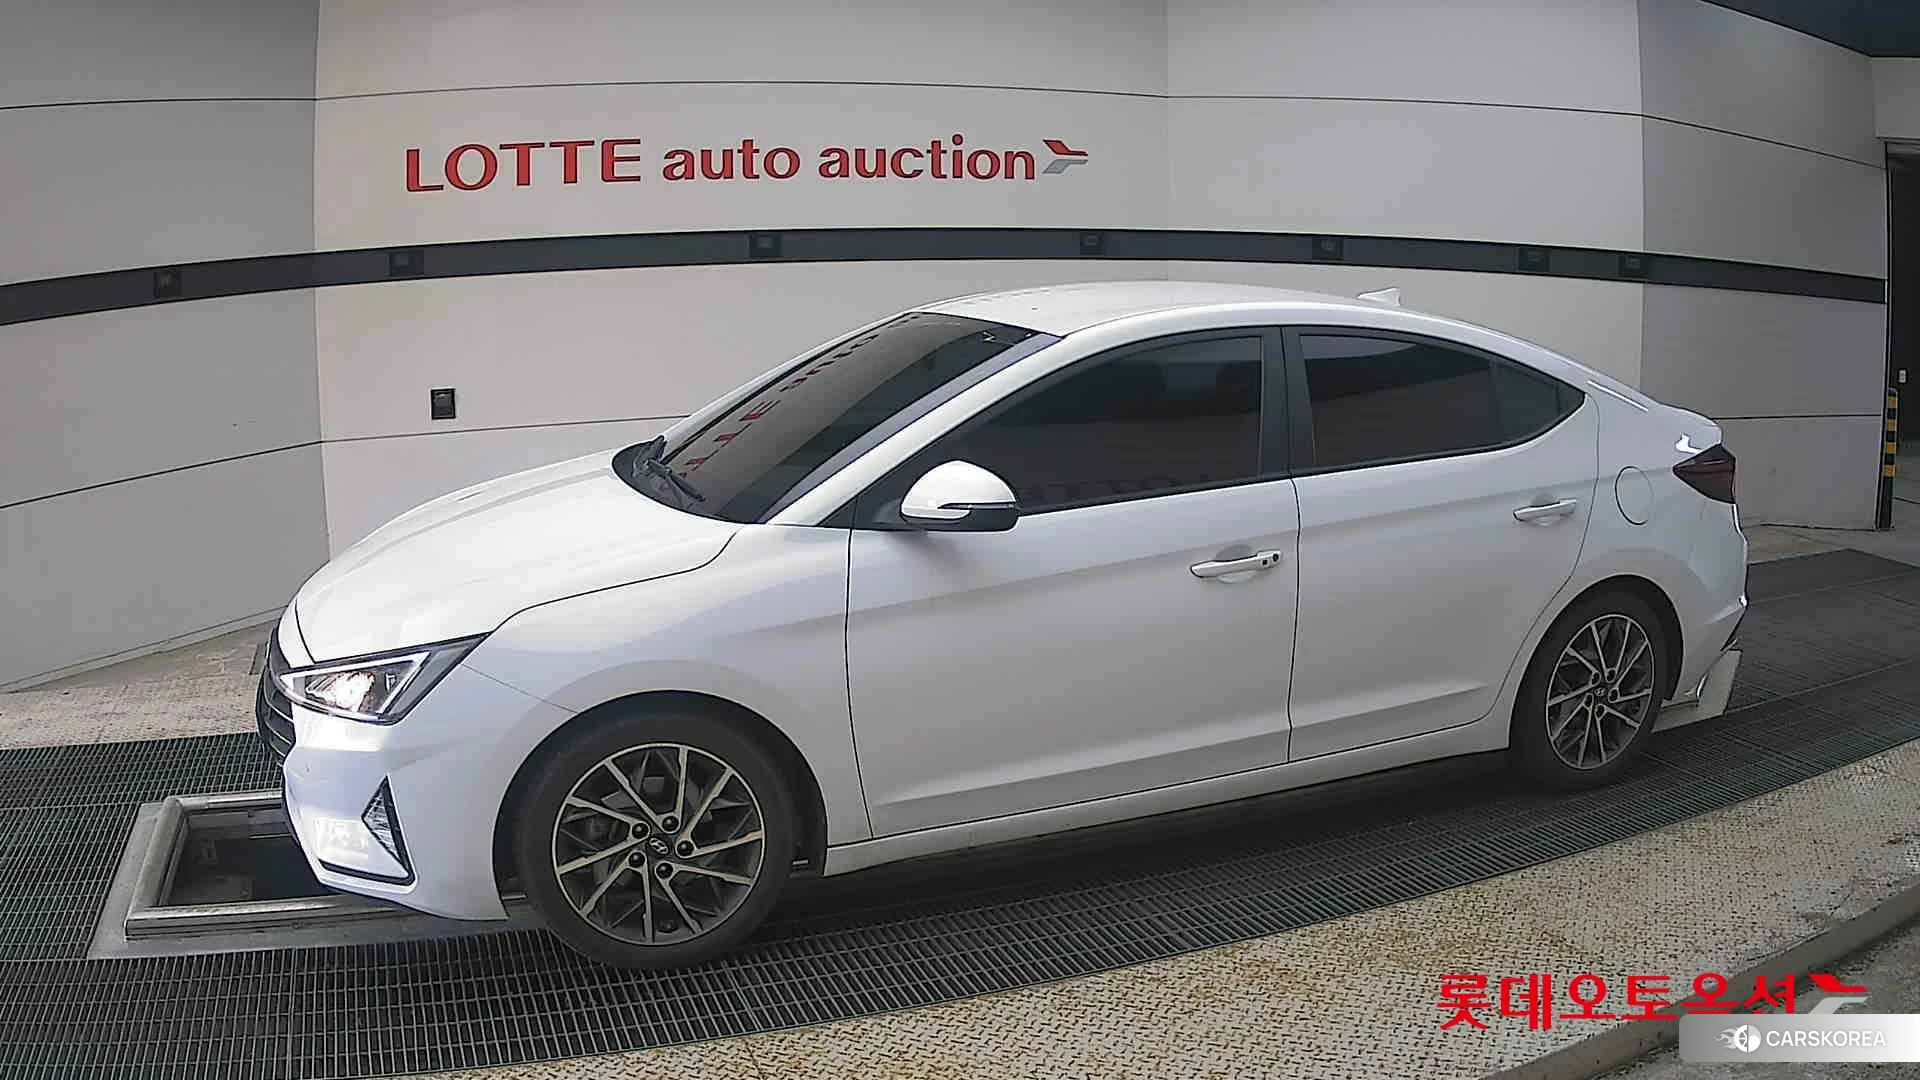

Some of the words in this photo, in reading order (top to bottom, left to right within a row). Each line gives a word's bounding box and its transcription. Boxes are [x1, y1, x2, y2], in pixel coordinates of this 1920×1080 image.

[404, 138, 641, 193] LOTTE
[662, 138, 801, 182] auto
[818, 134, 1037, 181] auction
